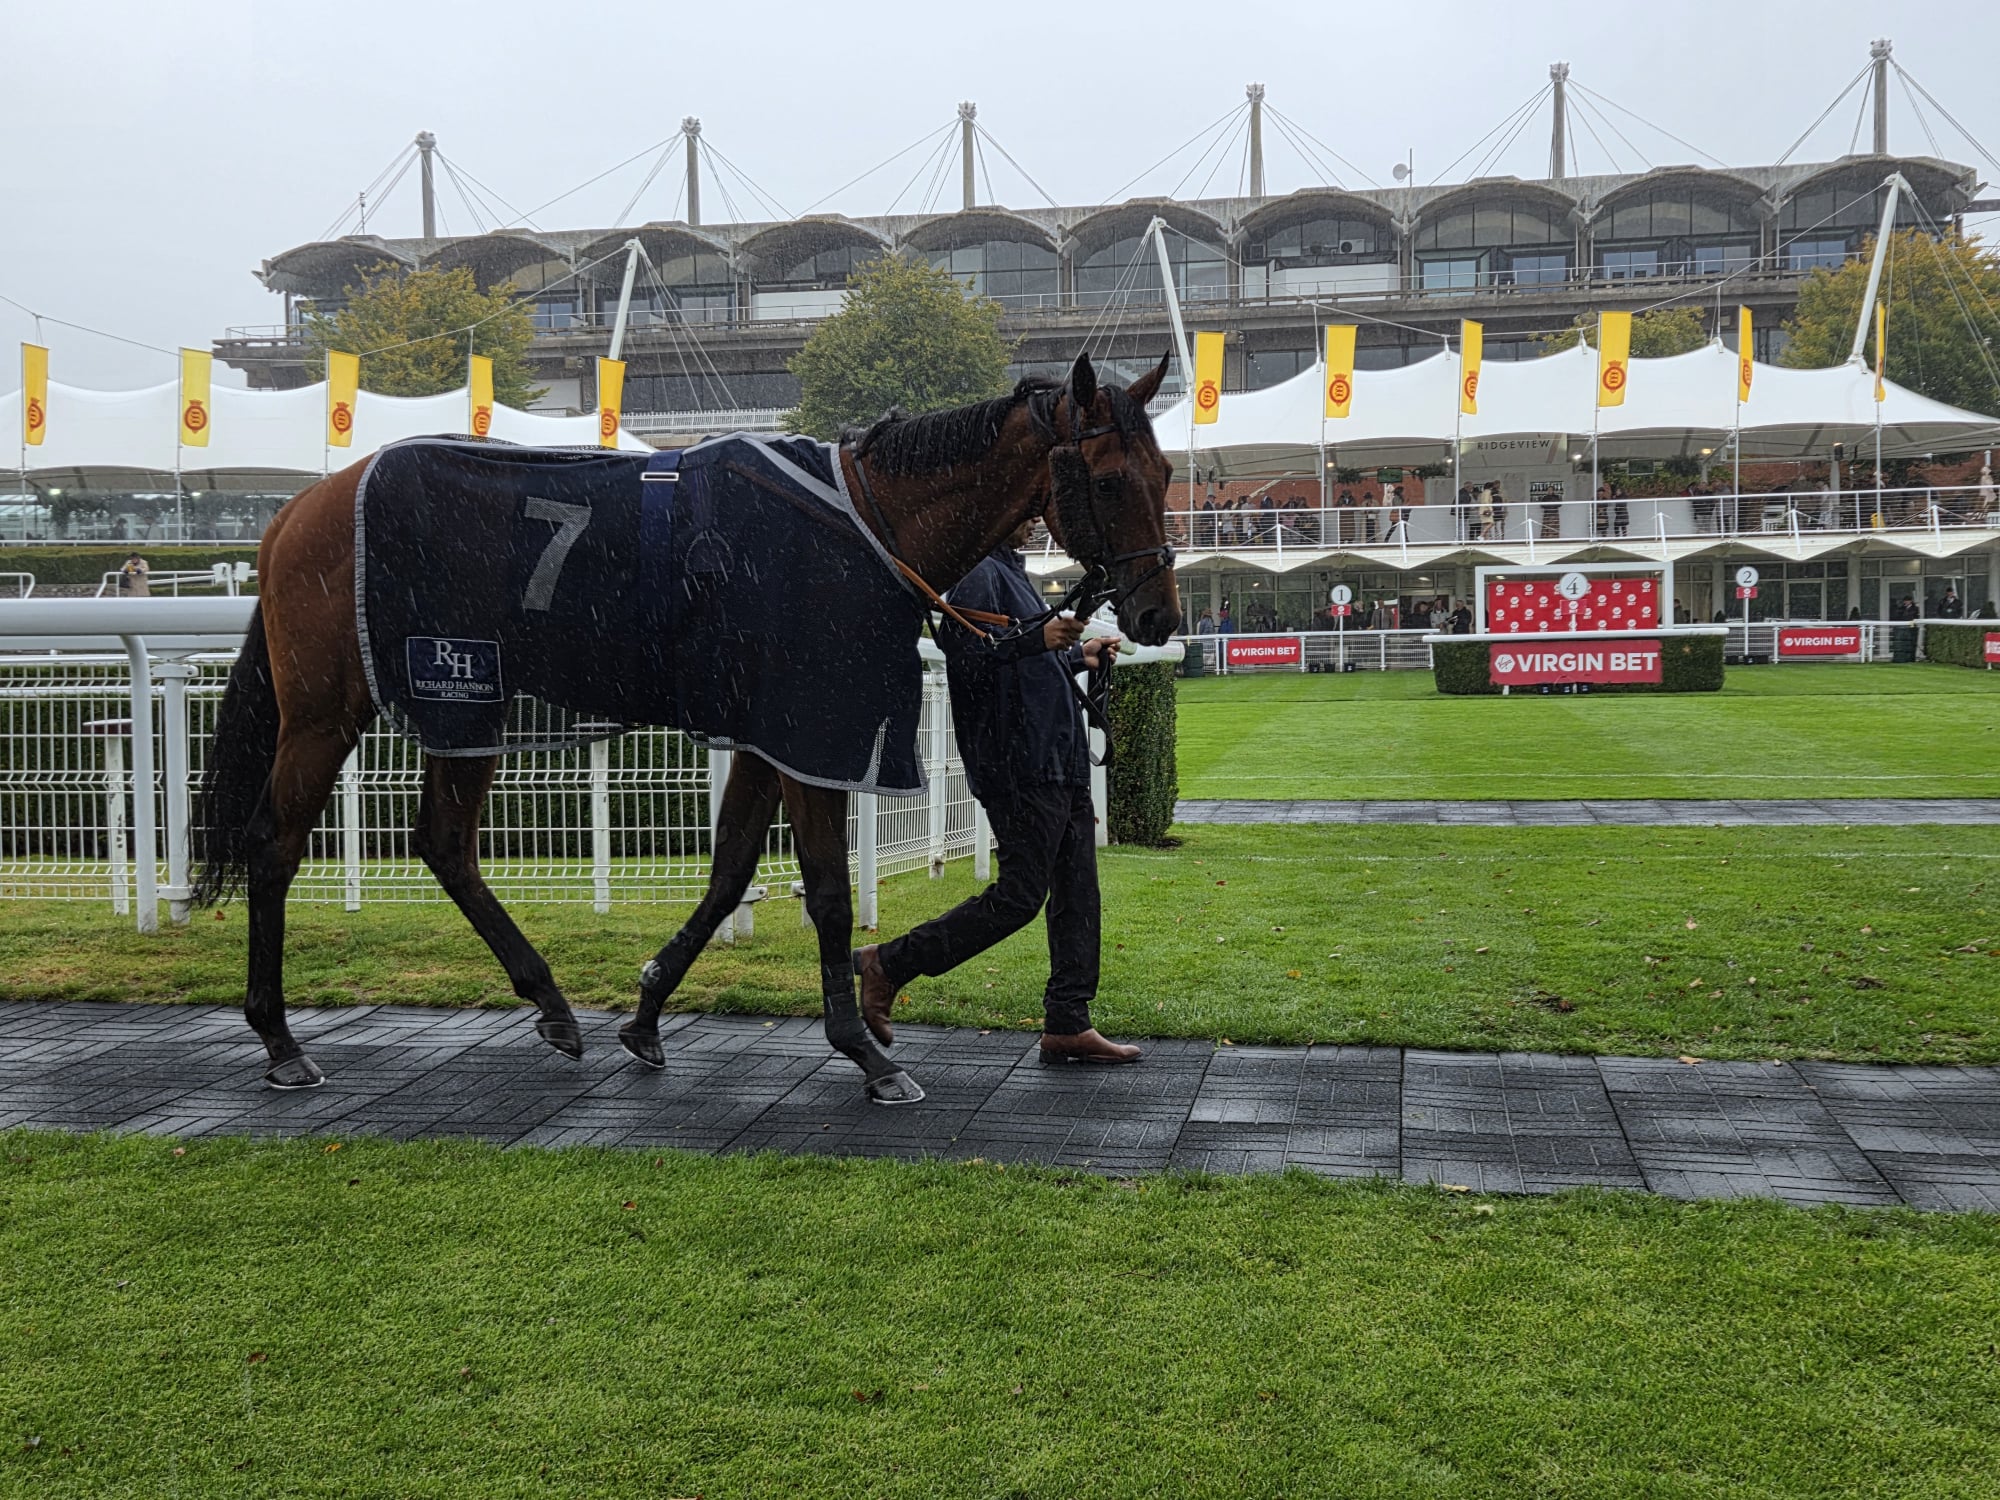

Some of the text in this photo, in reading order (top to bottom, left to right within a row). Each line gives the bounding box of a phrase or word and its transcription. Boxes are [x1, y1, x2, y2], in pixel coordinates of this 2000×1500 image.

[1477, 440, 1550, 450] RIDGEVIEW
[523, 496, 592, 612] 7
[1743, 571, 1752, 583] 2
[1566, 577, 1579, 594] 4
[1338, 589, 1344, 601] 1
[1794, 636, 1856, 646] VIRGIN BET
[1241, 646, 1296, 656] VIRGIN BET
[1516, 652, 1658, 672] VIRGIN BET
[415, 679, 494, 691] RICHARD HANNON
[440, 691, 469, 699] RACING
